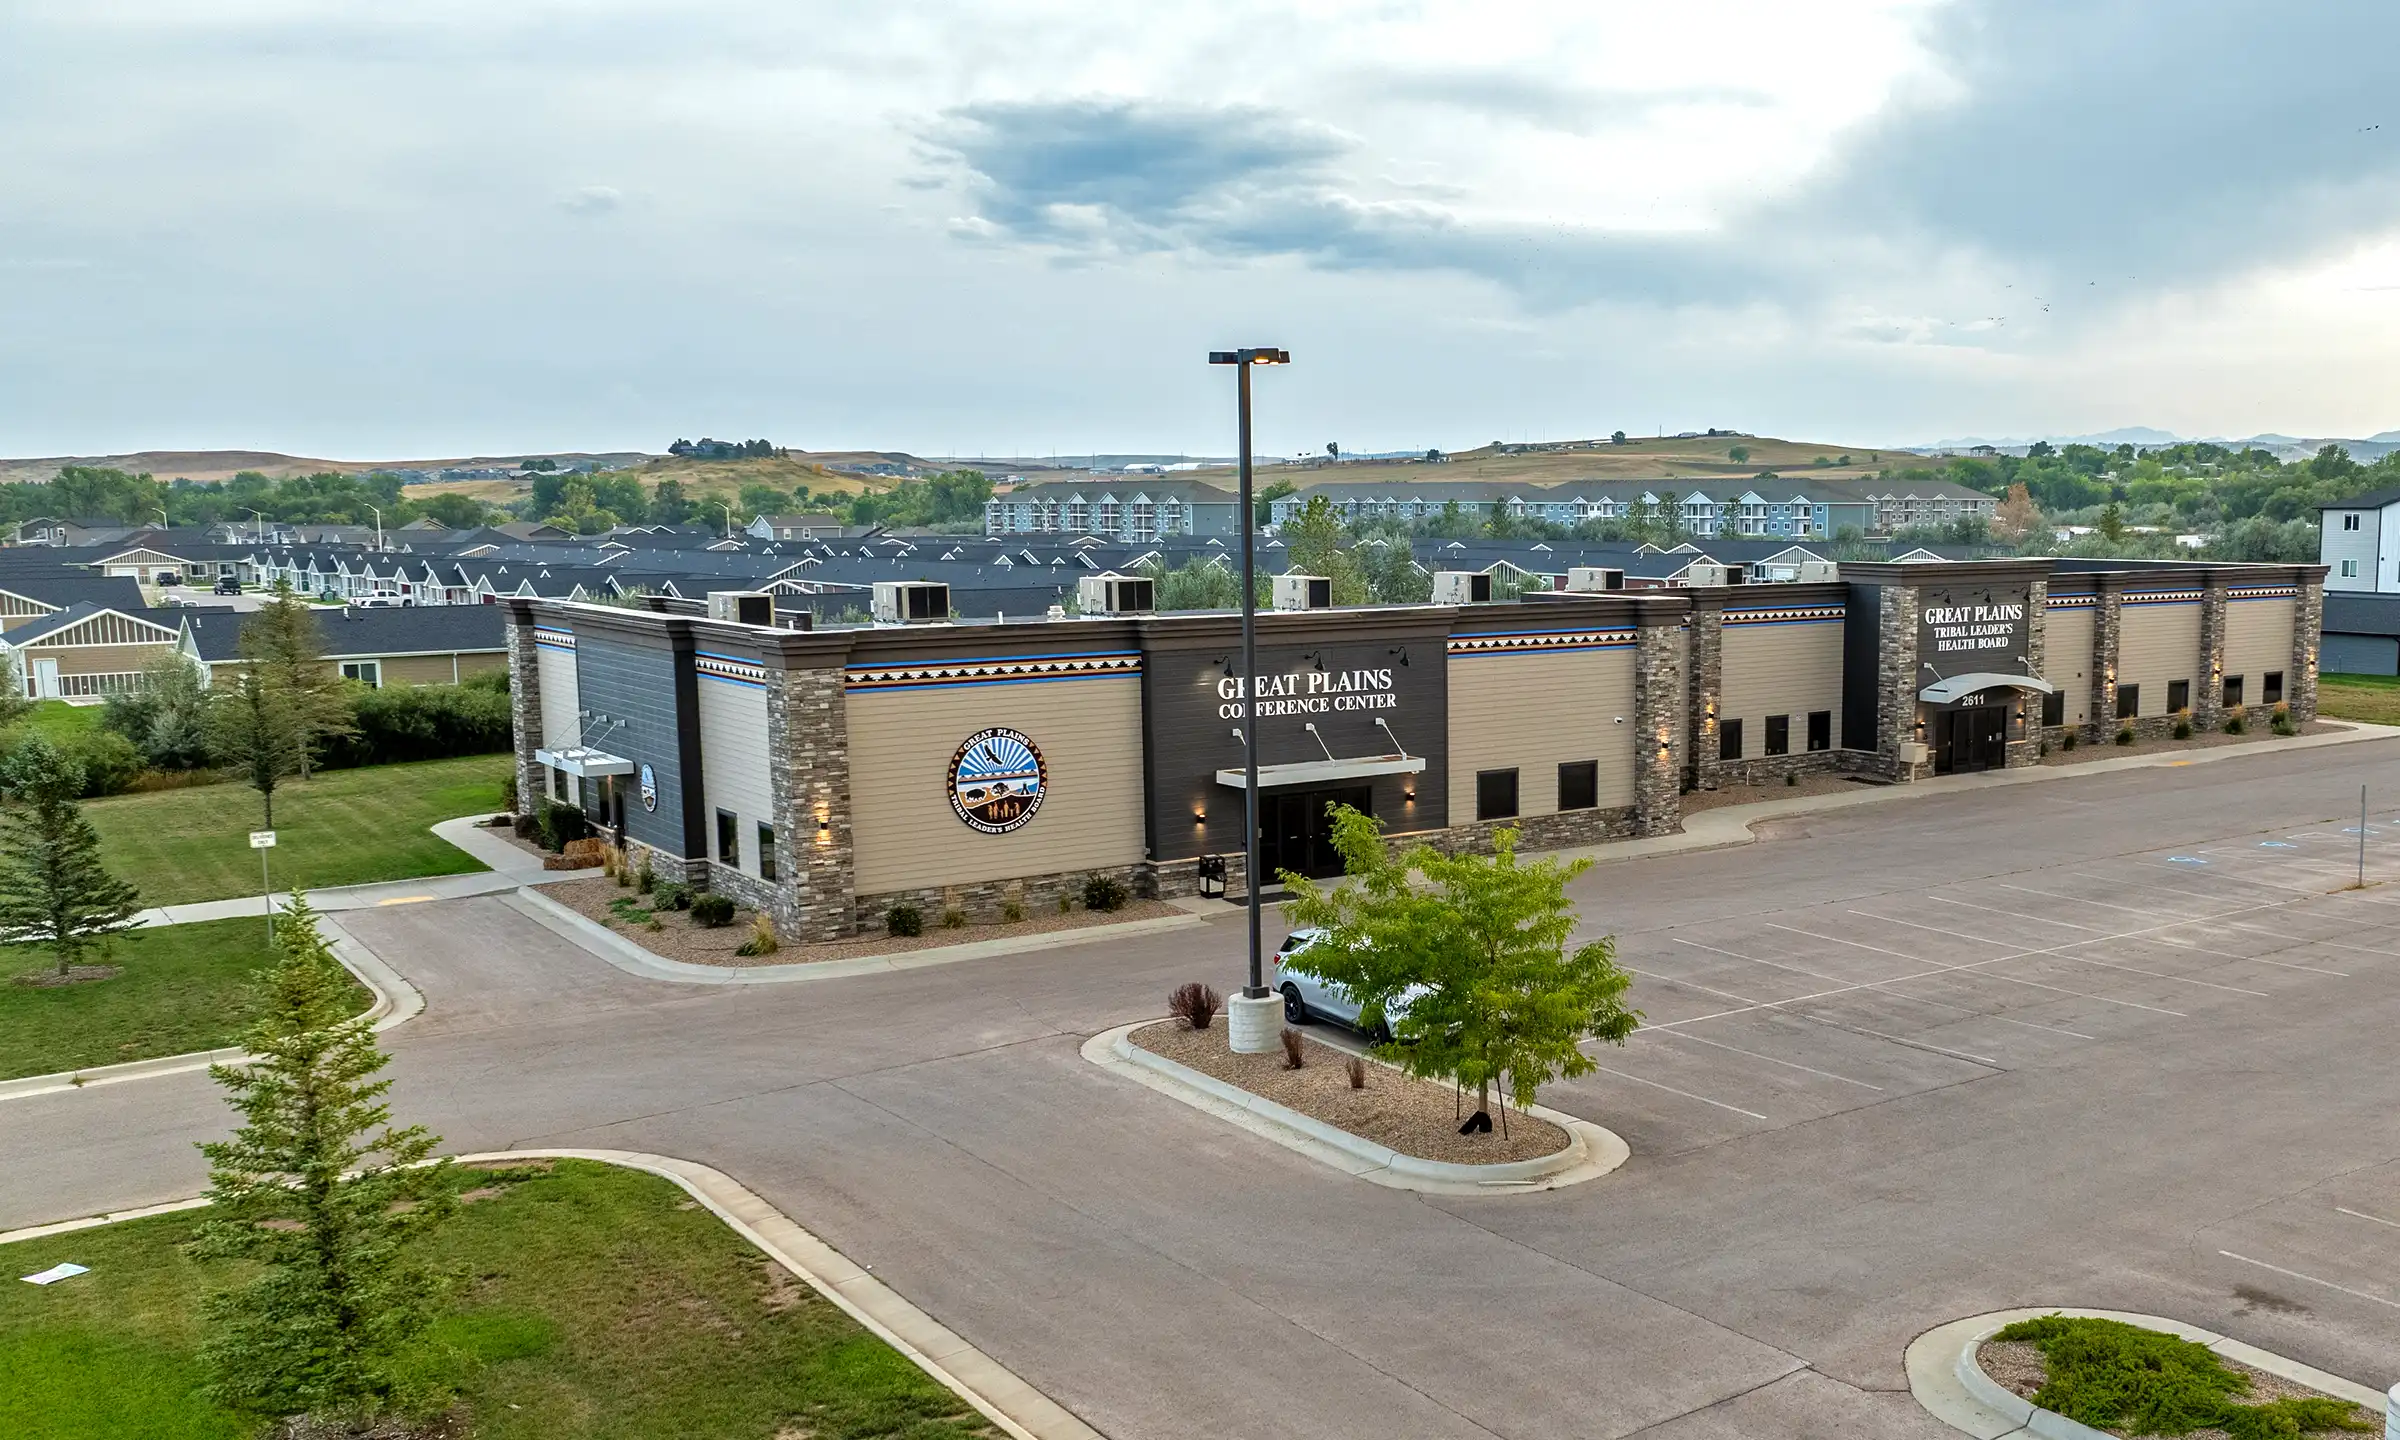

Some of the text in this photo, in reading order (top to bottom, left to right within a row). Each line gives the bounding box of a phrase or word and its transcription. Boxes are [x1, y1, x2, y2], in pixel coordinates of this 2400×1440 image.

[1925, 604, 2022, 624] GREAT PLAINS
[1934, 623, 2013, 638] TRIBAL LEADER'S
[1938, 636, 2009, 652] HEALTH BOARD
[1307, 668, 1393, 694] PLAINS
[1218, 692, 1397, 719] COFERENCE CENTER
[1962, 694, 1984, 706] 2611
[963, 728, 1030, 751] GREAT PLAINS
[951, 795, 968, 821] TRIBAL
[1005, 813, 1032, 832] HEALTH
[1032, 787, 1045, 812] BOARD
